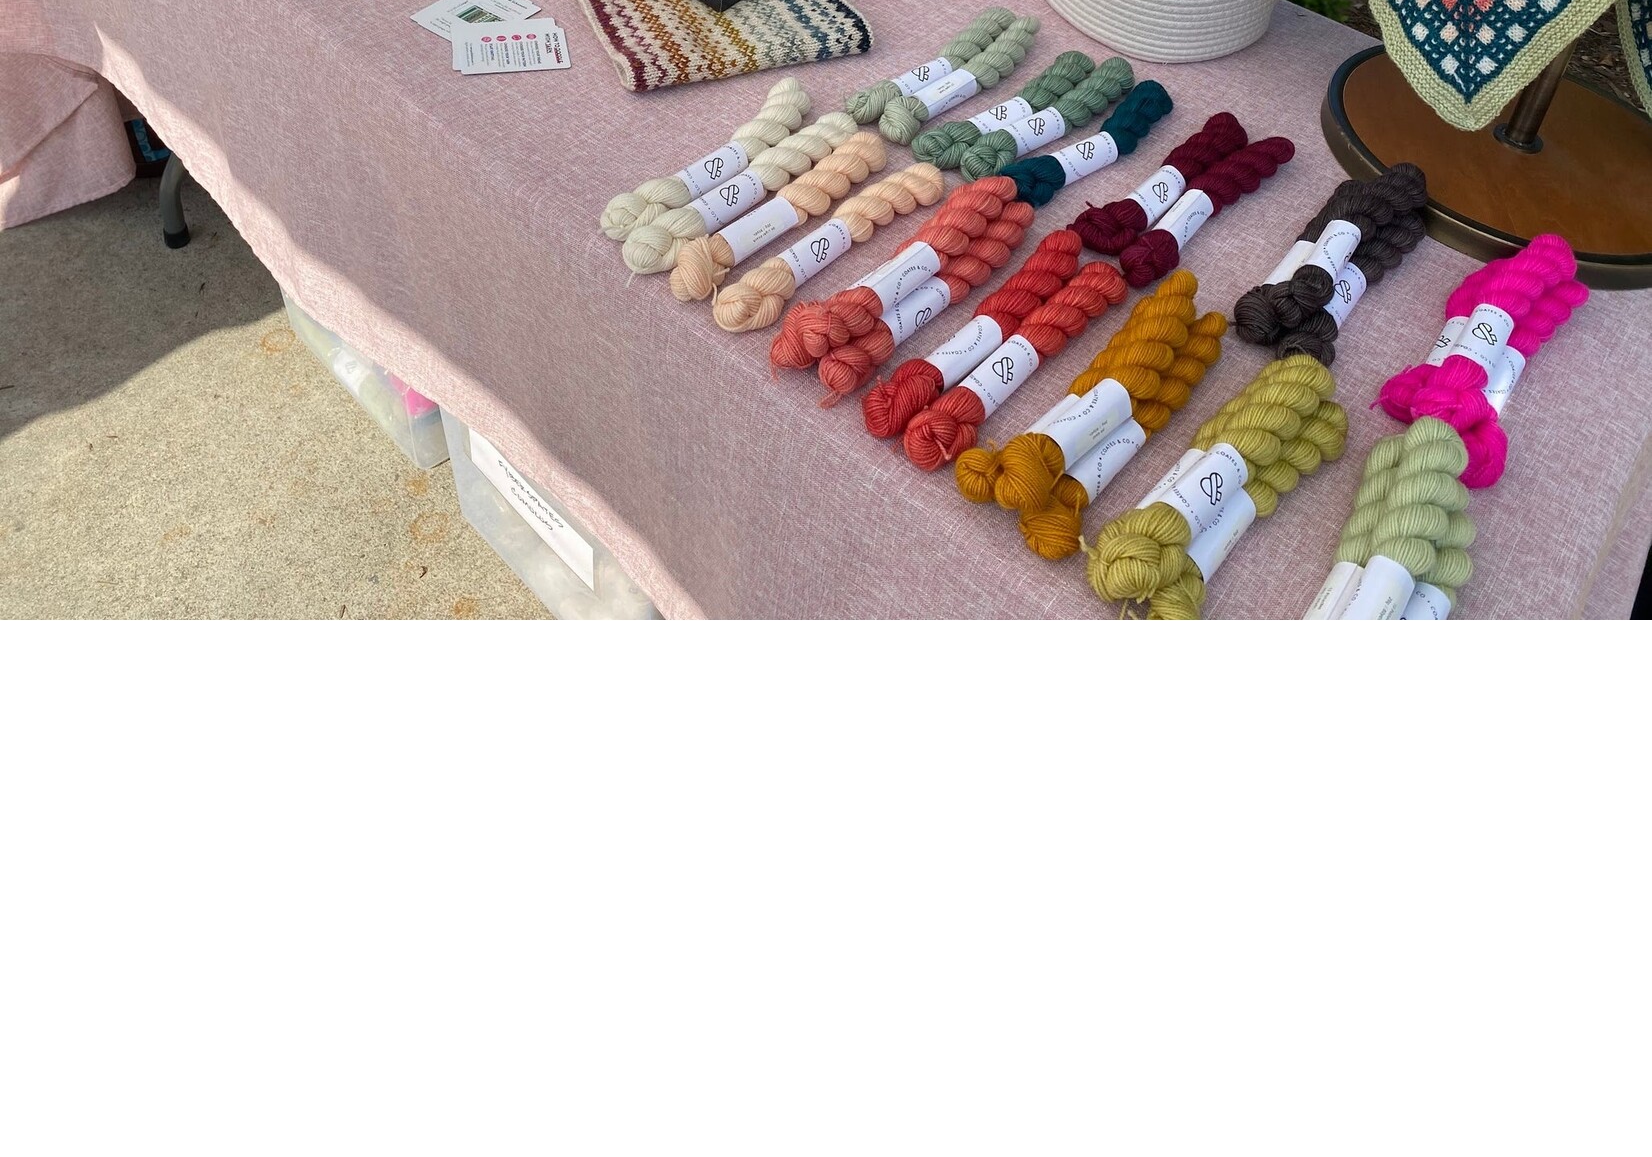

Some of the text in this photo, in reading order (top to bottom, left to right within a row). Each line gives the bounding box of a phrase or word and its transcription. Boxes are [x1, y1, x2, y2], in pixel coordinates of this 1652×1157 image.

[901, 265, 917, 278] COATES
[1100, 440, 1117, 456] COATES
[1215, 450, 1238, 467] COATES
